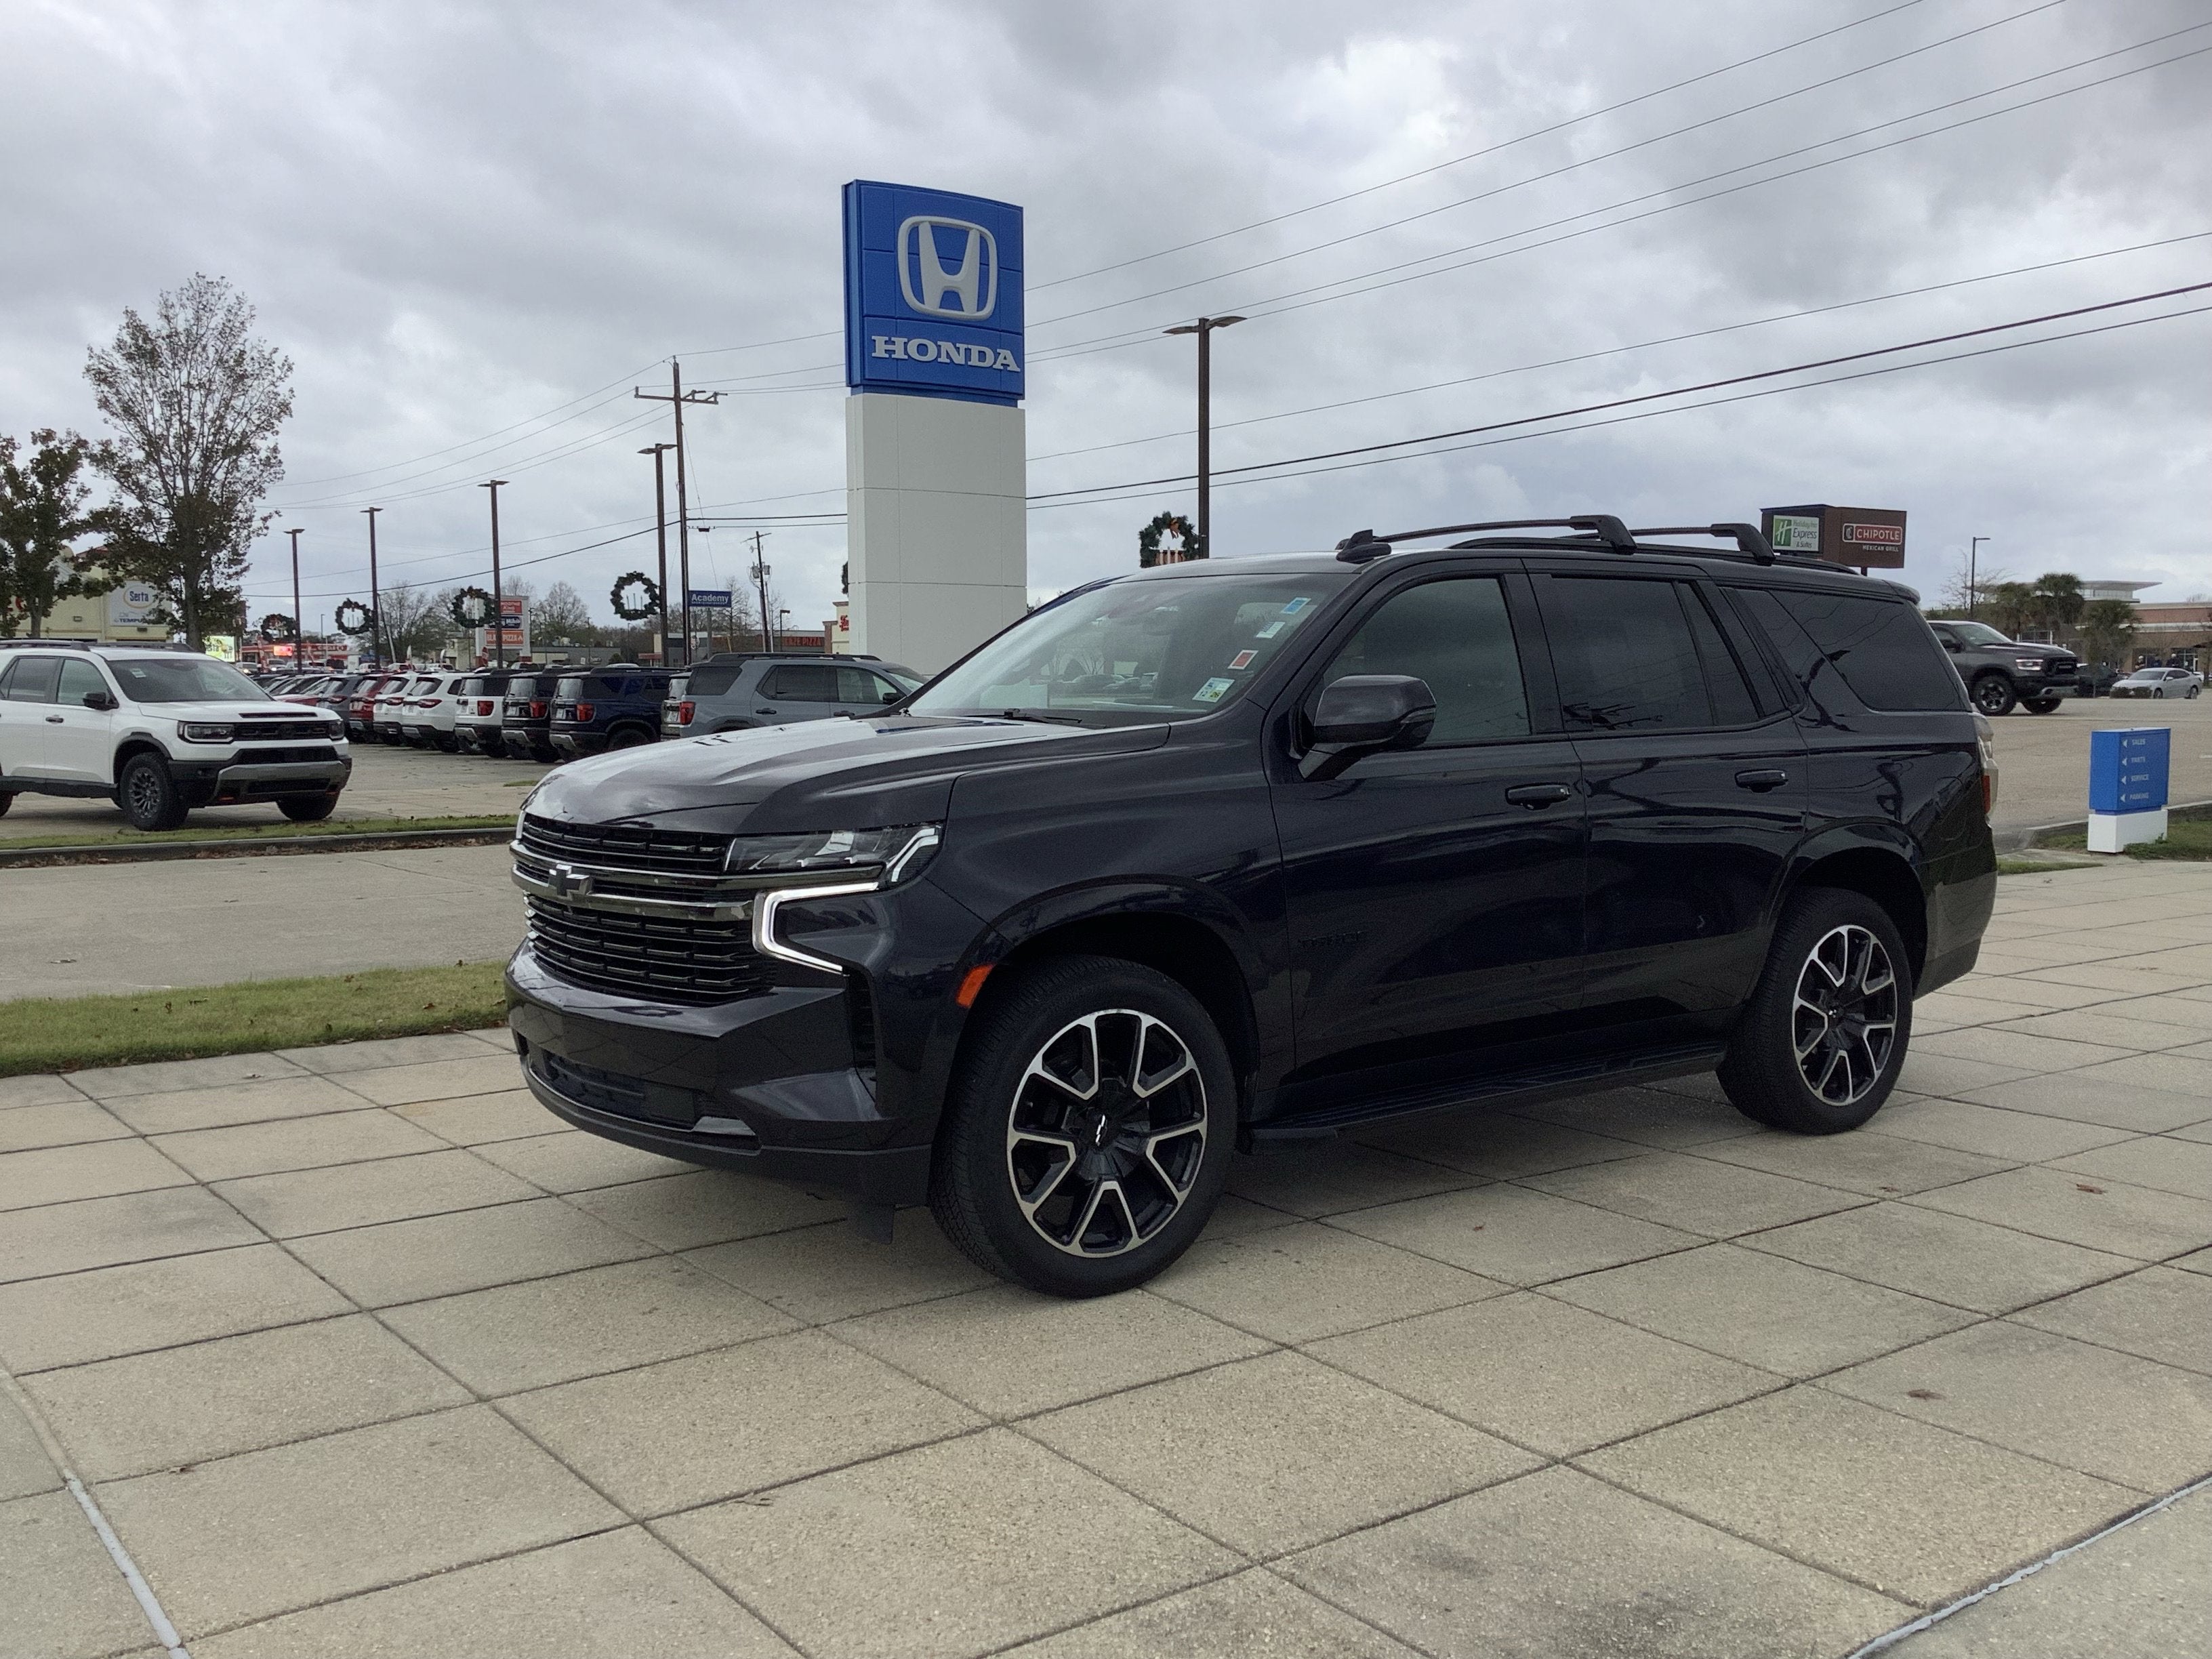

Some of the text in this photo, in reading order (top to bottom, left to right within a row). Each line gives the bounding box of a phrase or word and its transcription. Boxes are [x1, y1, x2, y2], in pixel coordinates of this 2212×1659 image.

[872, 335, 1021, 373] HONDA
[1793, 528, 1817, 541] Express
[1856, 529, 1900, 541] CHIPOTLE
[129, 591, 149, 602] Serta
[691, 594, 729, 604] Academy
[802, 637, 821, 646] PIZZA
